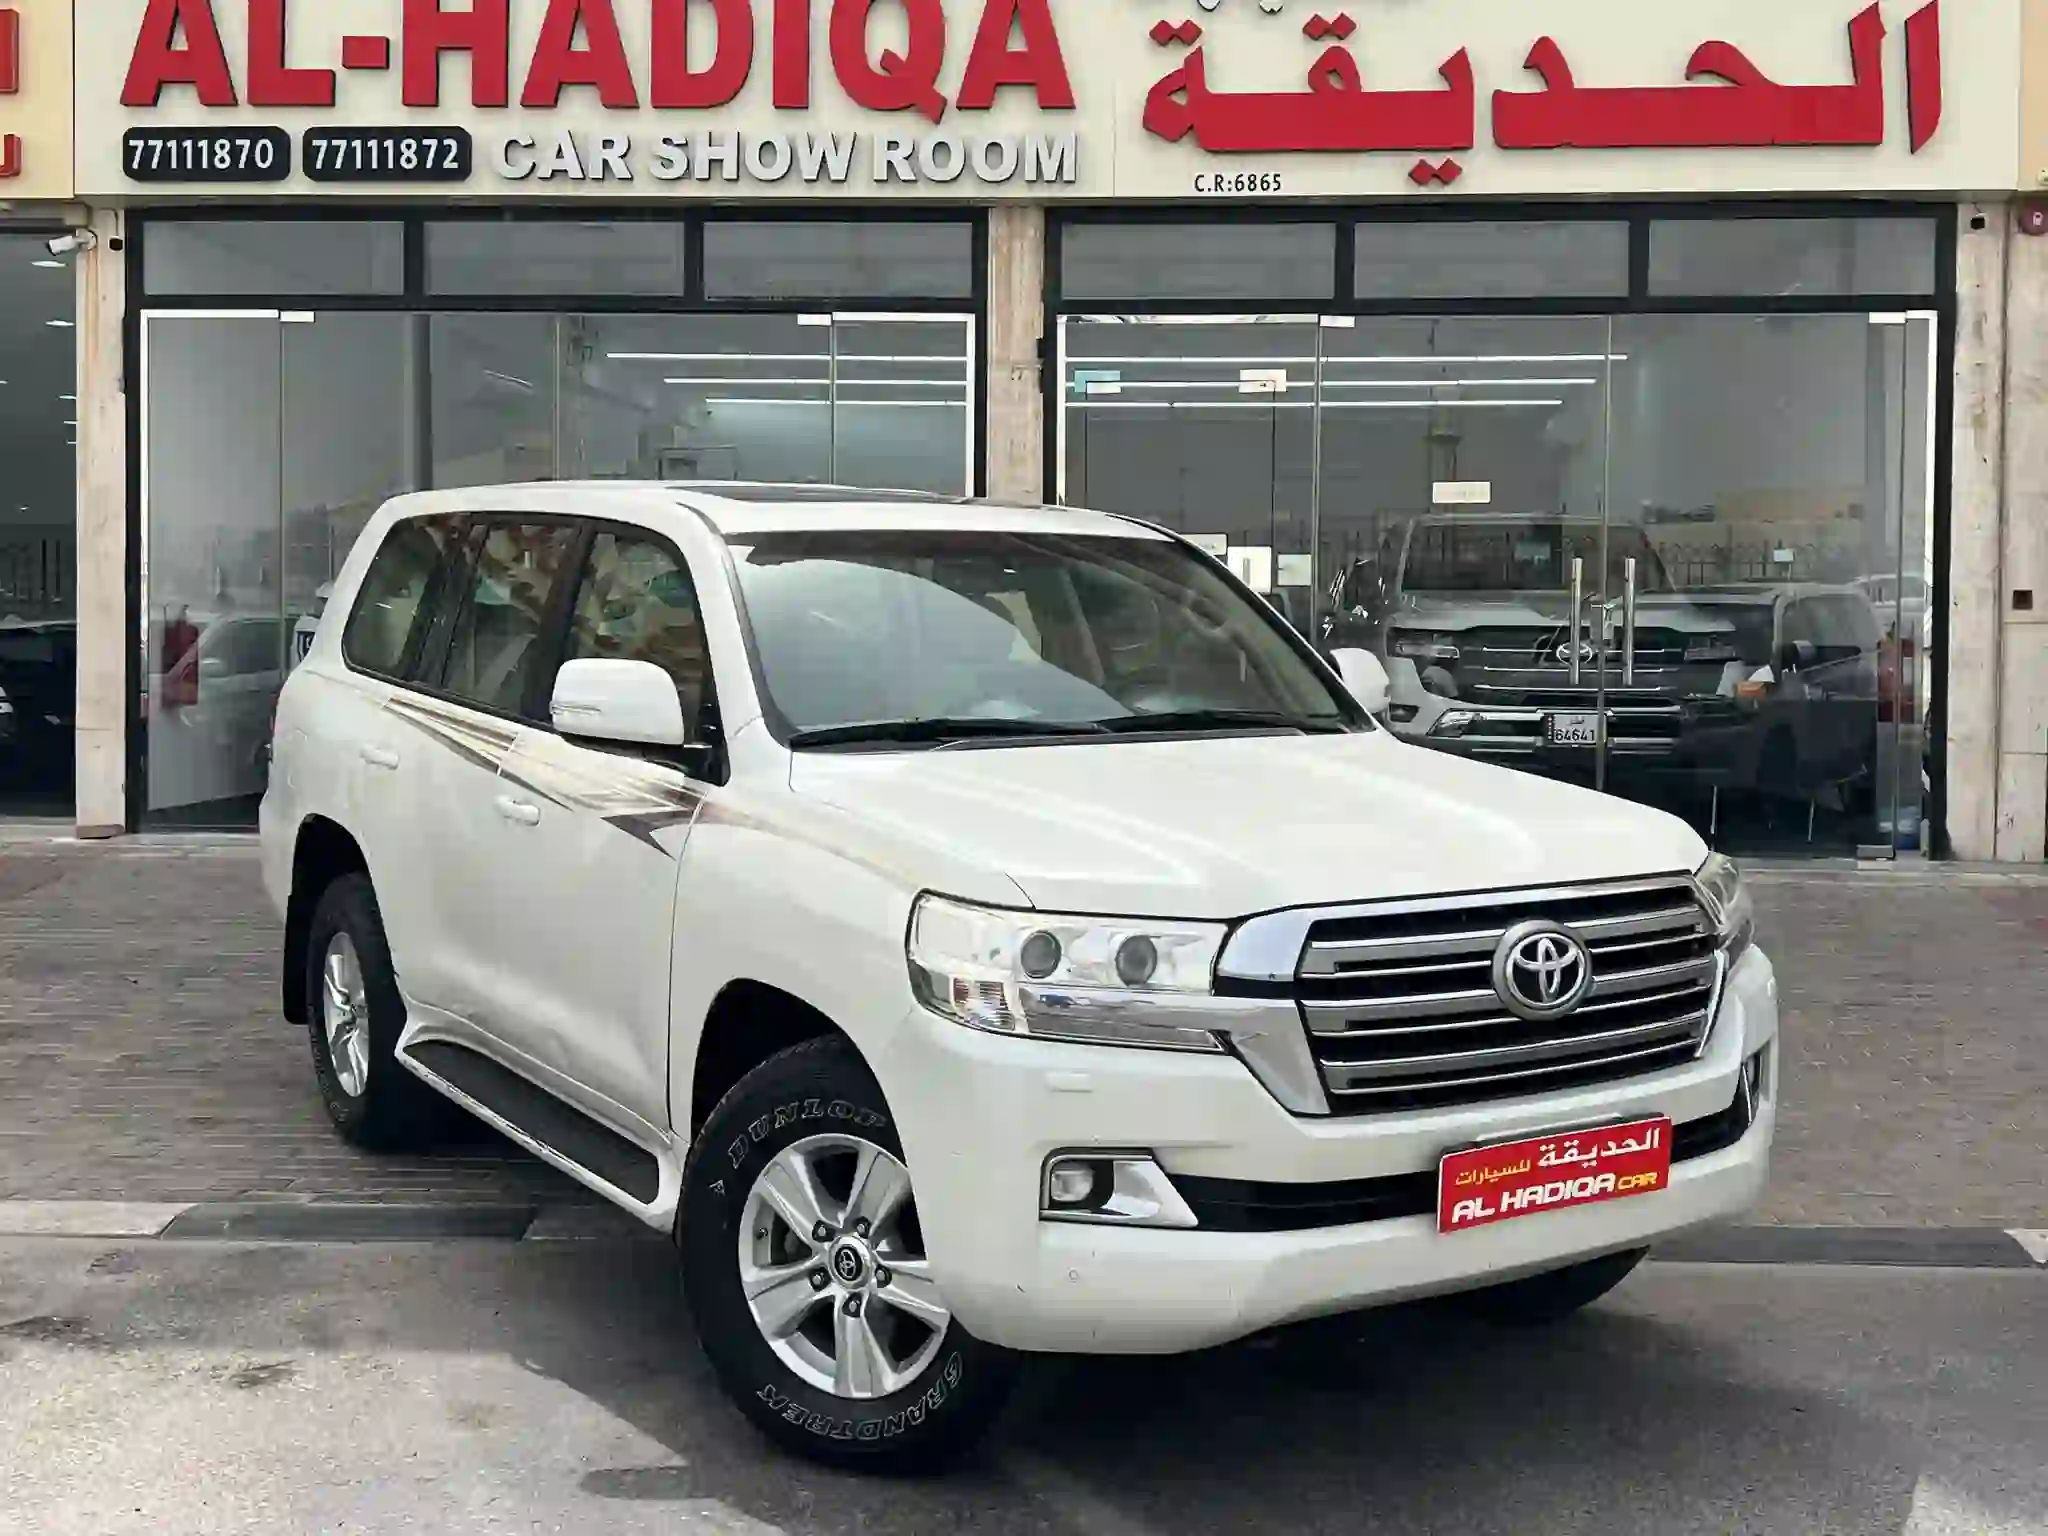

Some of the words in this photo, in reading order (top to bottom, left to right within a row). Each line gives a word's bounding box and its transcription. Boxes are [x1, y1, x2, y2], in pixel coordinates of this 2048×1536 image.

[120, 0, 1077, 123] AL-HADIQA
[1142, 0, 1943, 187] الحديقة
[128, 138, 274, 170] 77111870
[311, 138, 460, 170] 77111872
[498, 131, 632, 181] CAR
[649, 131, 857, 181] SHOW
[872, 131, 1077, 182] ROOM
[1194, 173, 1282, 193] C.R:6865
[728, 1098, 888, 1170] DUNLOP
[1537, 1127, 1661, 1168] الحديقة
[1451, 1197, 1496, 1224] AL
[1500, 1173, 1616, 1213] HADIQA
[1617, 1171, 1658, 1191] CAR
[1455, 1159, 1531, 1186] للسيارات
[756, 1351, 963, 1440] GRANDTREK
